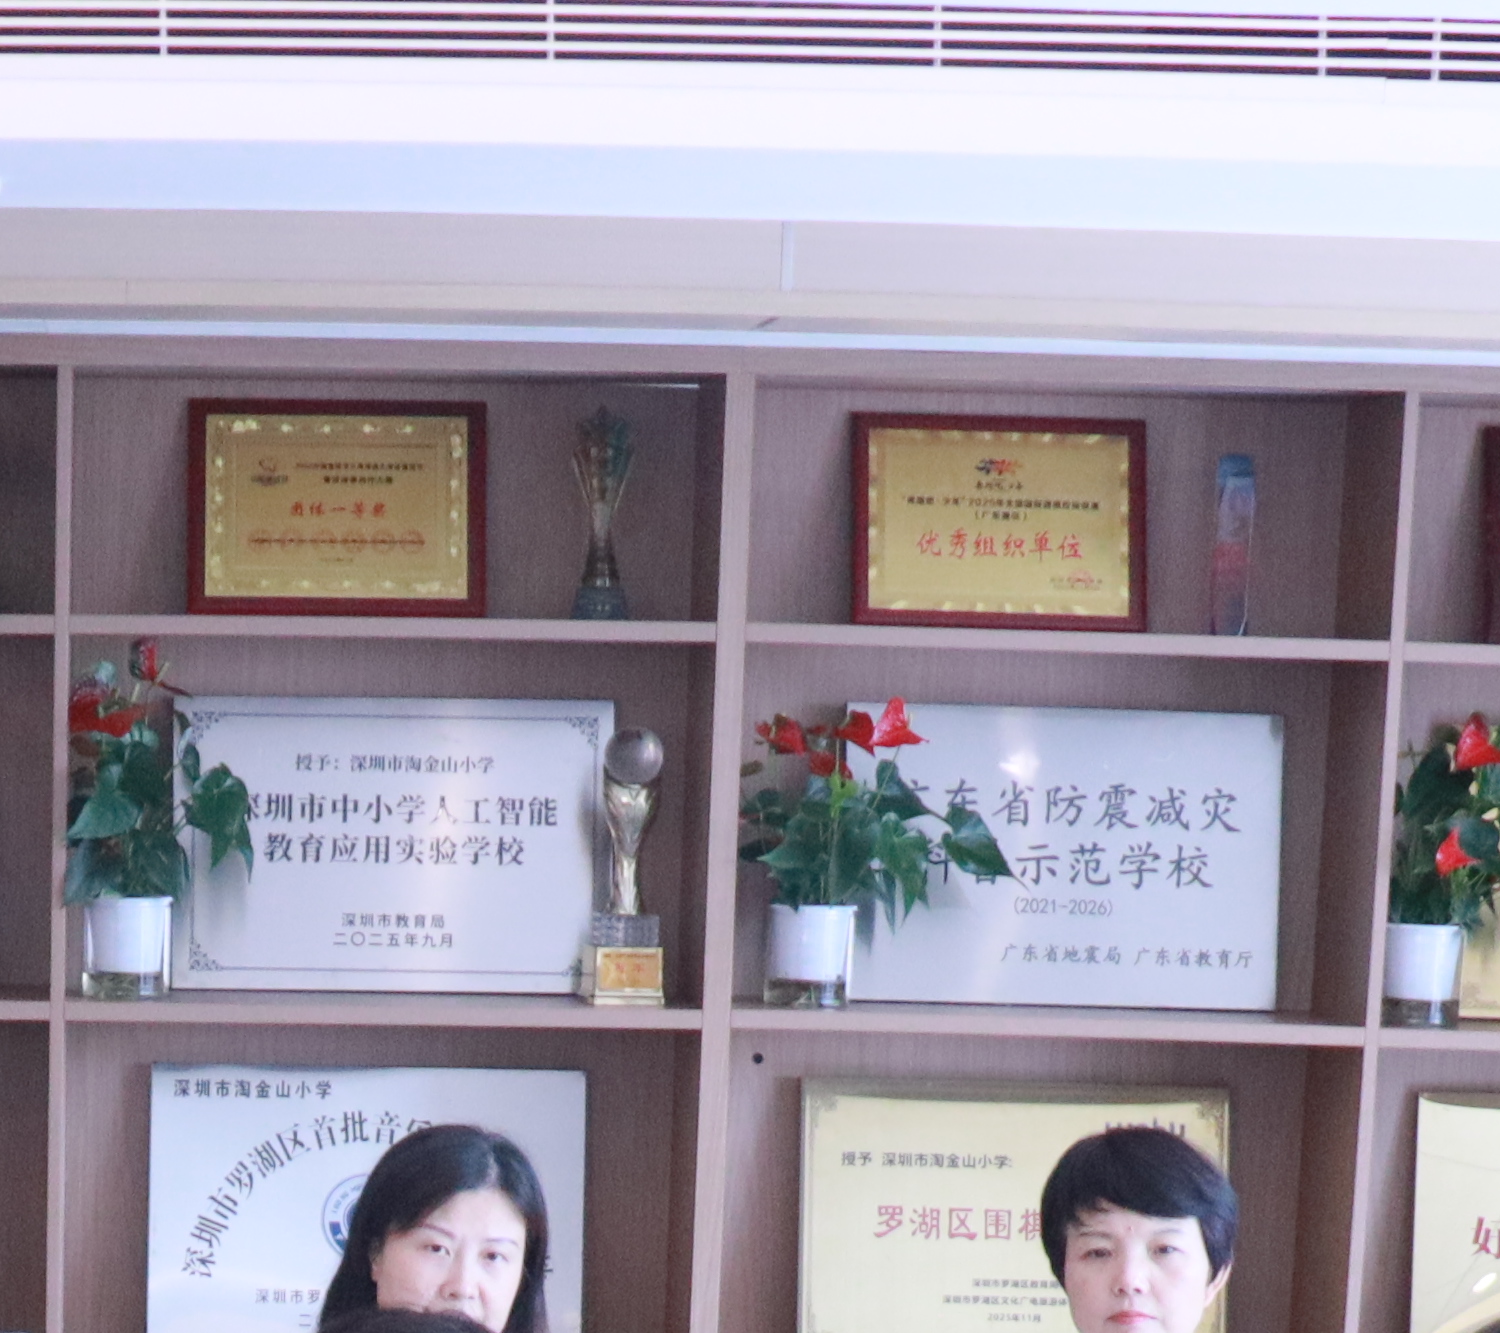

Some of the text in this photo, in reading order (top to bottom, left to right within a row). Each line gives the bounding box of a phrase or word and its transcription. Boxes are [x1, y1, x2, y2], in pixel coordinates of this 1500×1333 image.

[916, 527, 1084, 562] 优秀组织单位
[263, 832, 526, 867] 教育应用实验学校
[341, 913, 446, 929] 深圳市教育局
[1001, 944, 1254, 969] 广东省地震局 广东省教育厅
[173, 1079, 333, 1099] 深圳市淘金山小学
[841, 1149, 873, 1168] 授予
